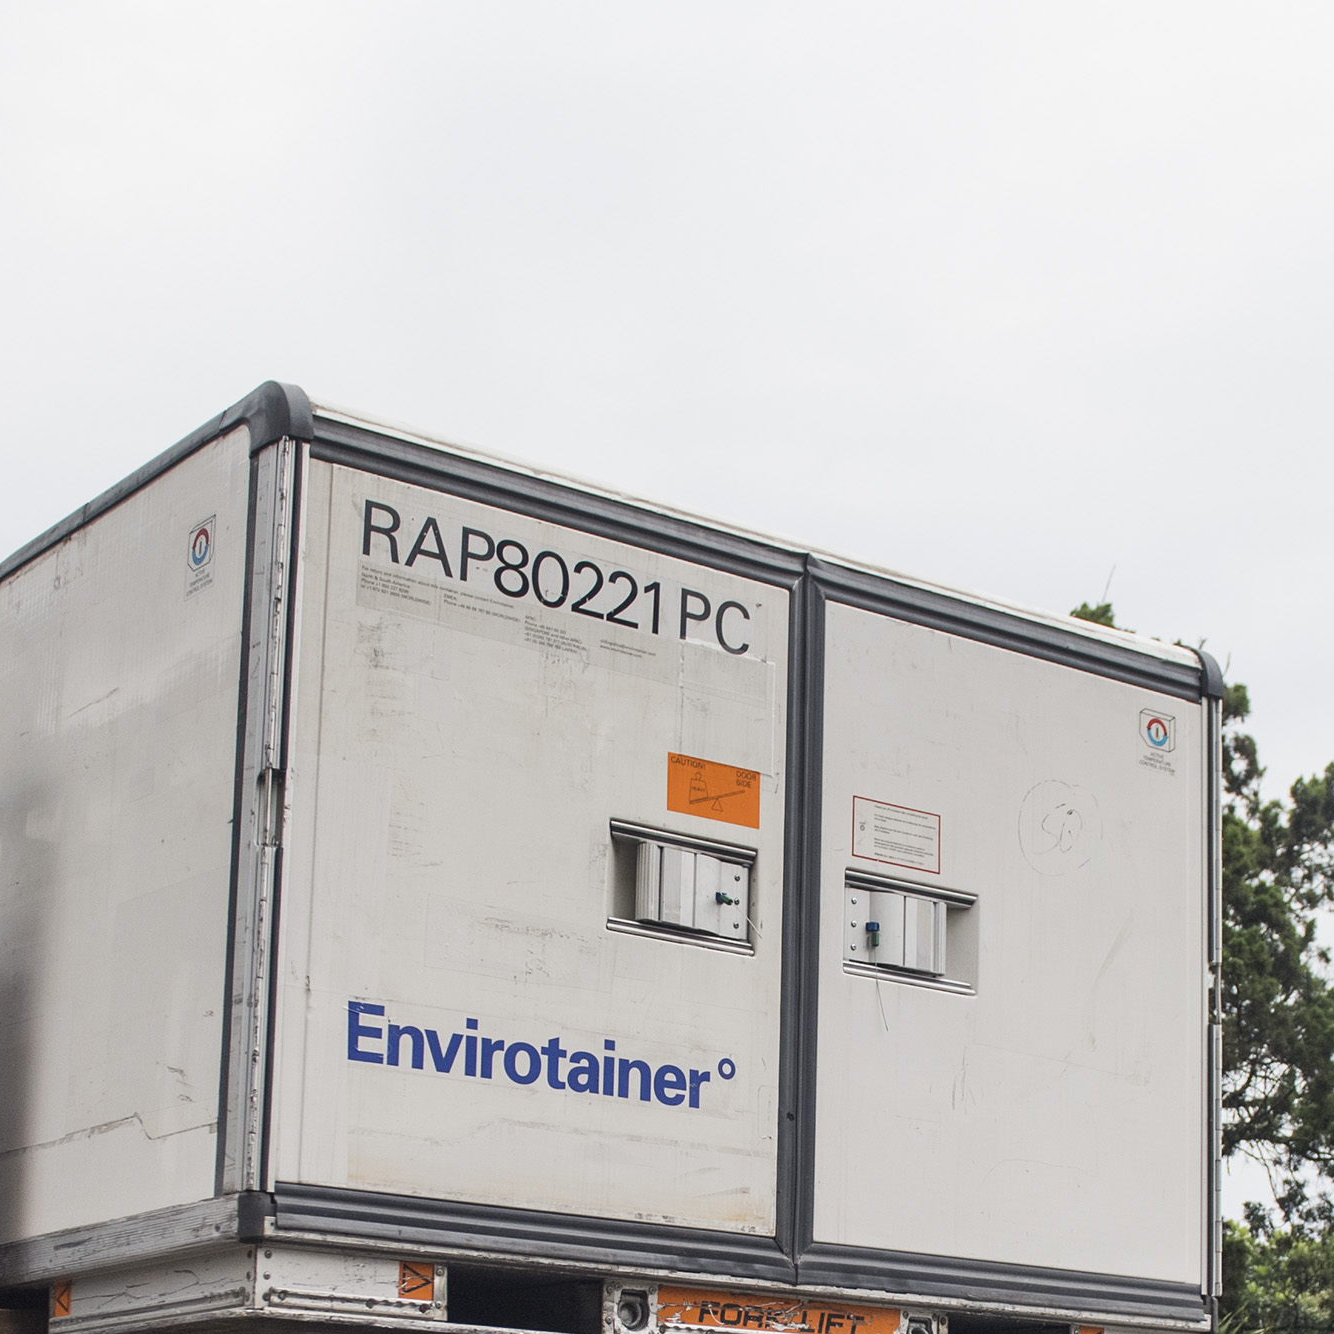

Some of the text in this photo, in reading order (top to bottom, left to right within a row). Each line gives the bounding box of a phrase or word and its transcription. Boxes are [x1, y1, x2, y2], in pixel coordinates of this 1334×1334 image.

[670, 755, 706, 770] CAUTION!
[735, 770, 757, 781] DOOR
[735, 779, 752, 789] SIDE
